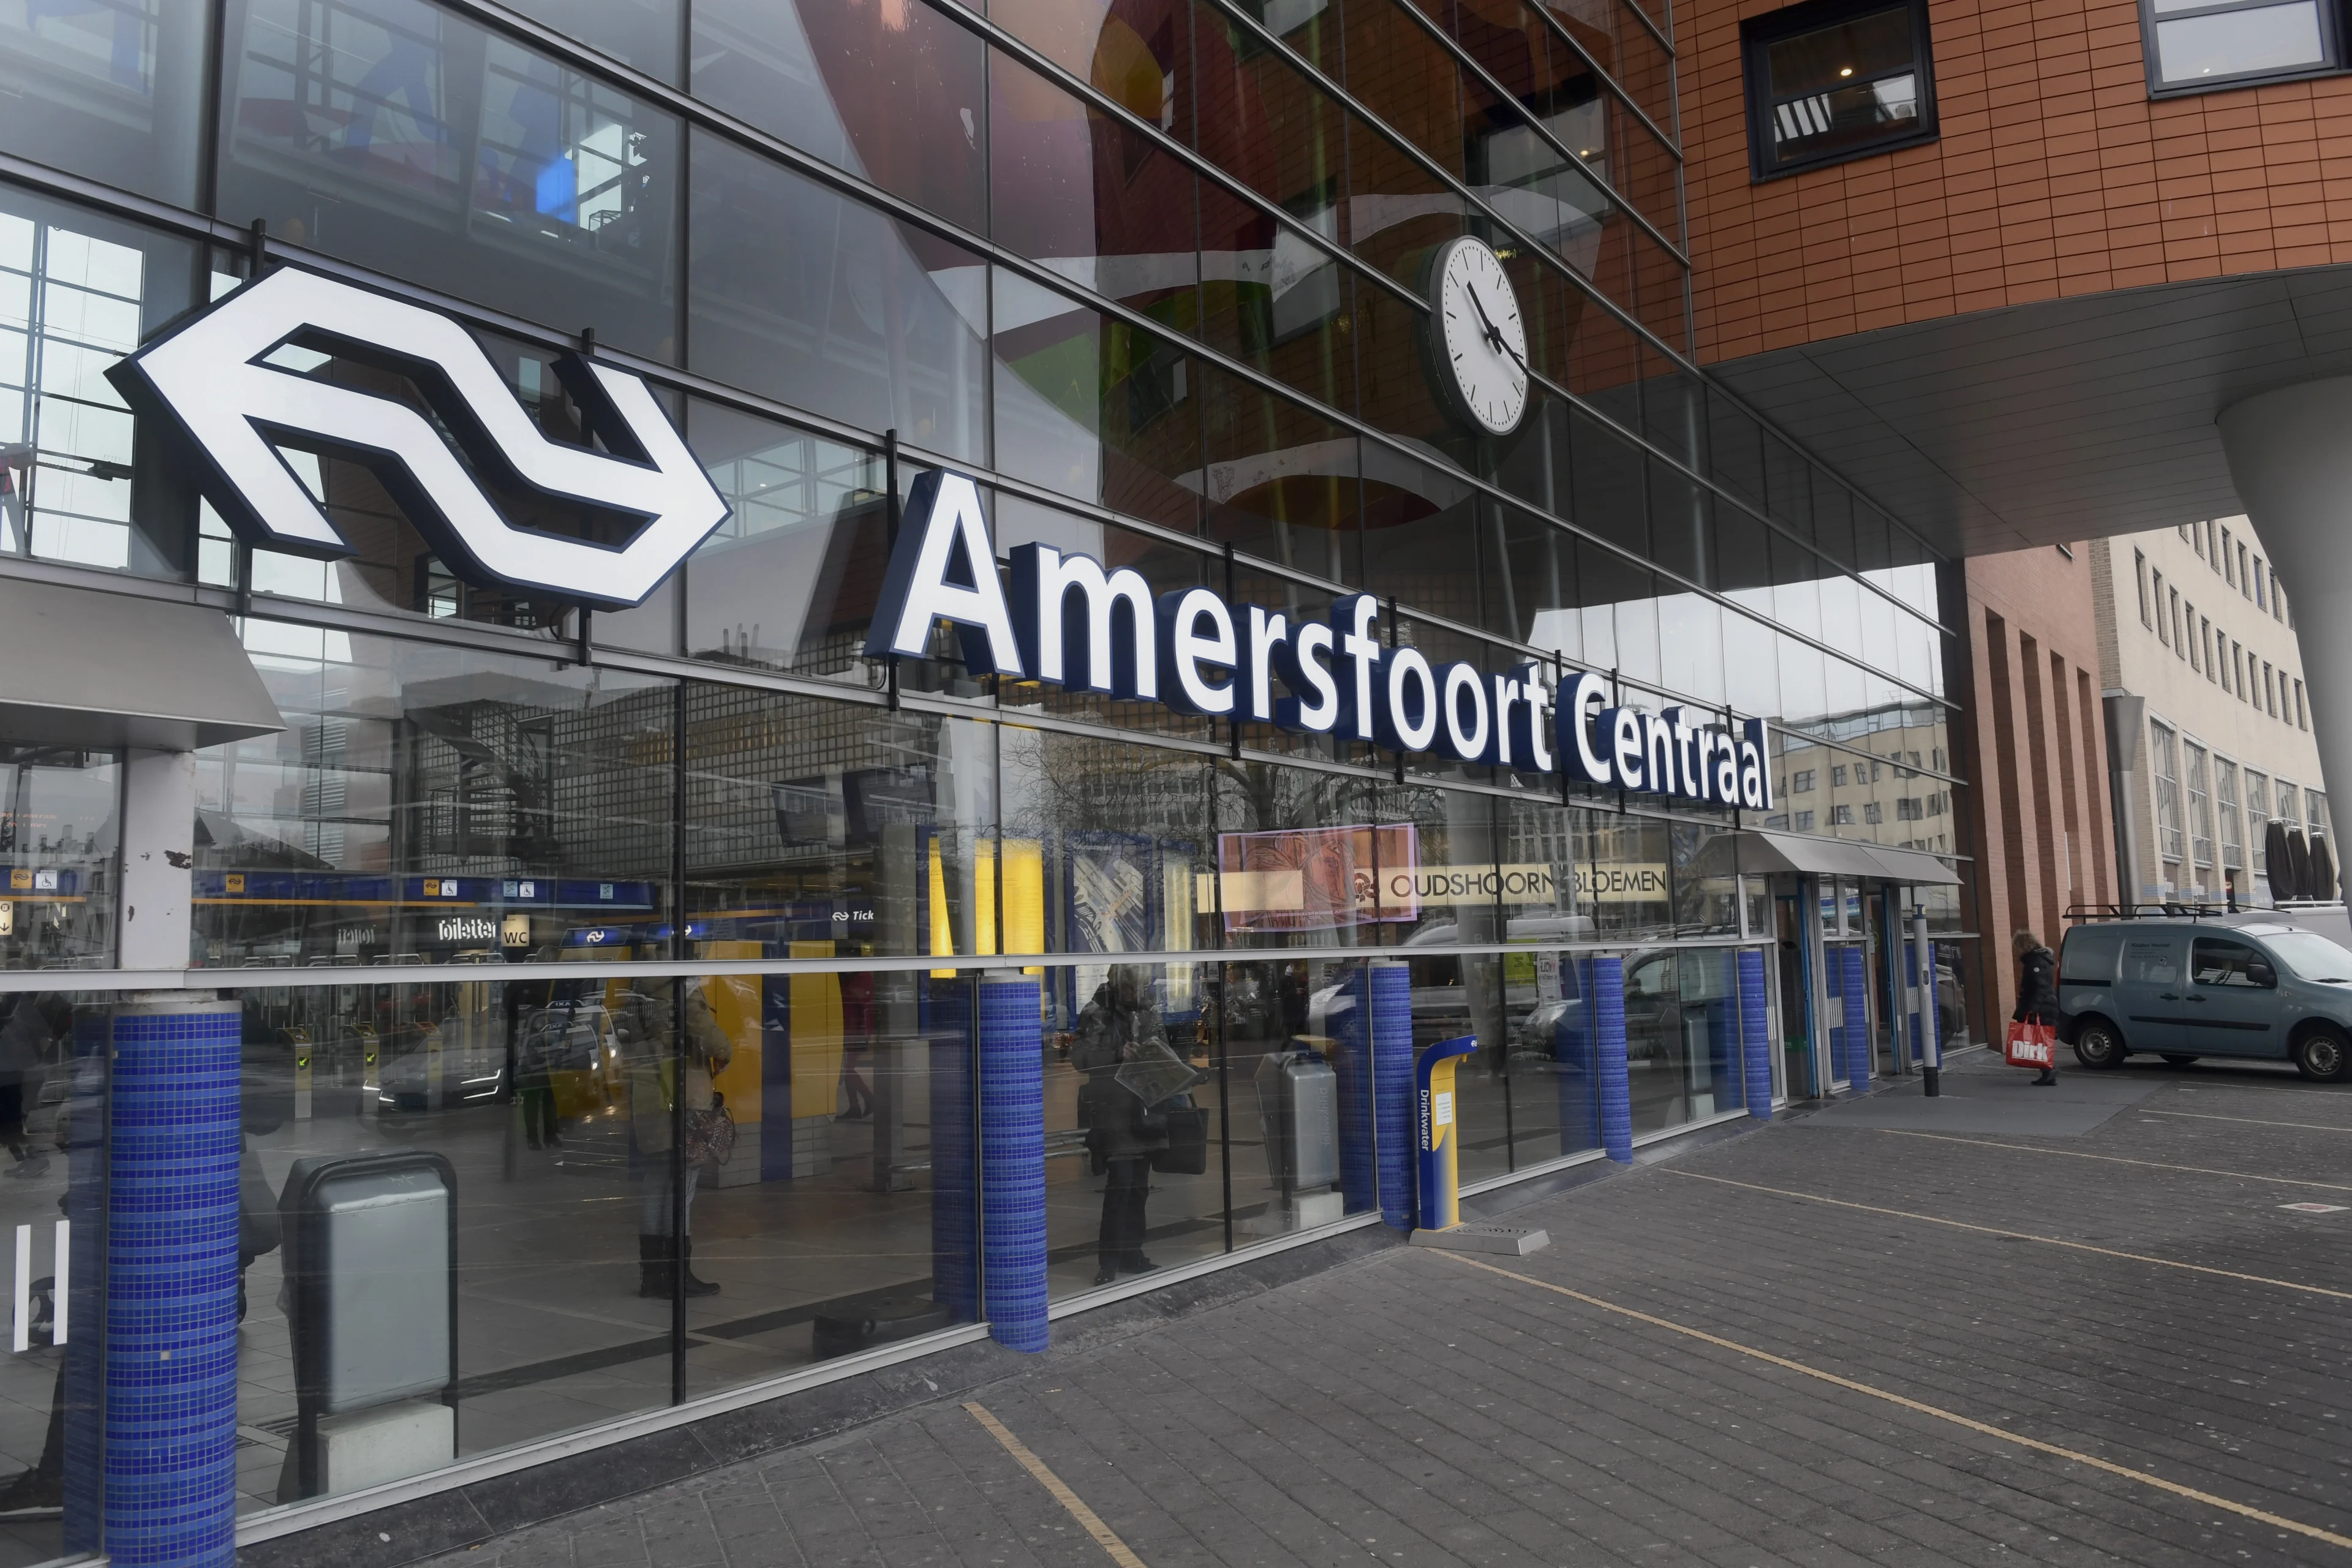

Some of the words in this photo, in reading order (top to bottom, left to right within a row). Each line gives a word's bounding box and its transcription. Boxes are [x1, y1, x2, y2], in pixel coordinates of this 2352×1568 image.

[888, 467, 1553, 774] Amersfoort
[1574, 671, 1774, 812] Centraal
[1391, 871, 1554, 897] OUDSHOORN
[1574, 870, 1667, 893] BLOEMEN
[853, 910, 873, 920] Tick
[504, 932, 527, 944] WC
[2011, 1040, 2048, 1061] Dirk
[1420, 1090, 1430, 1152] Drinkwater
